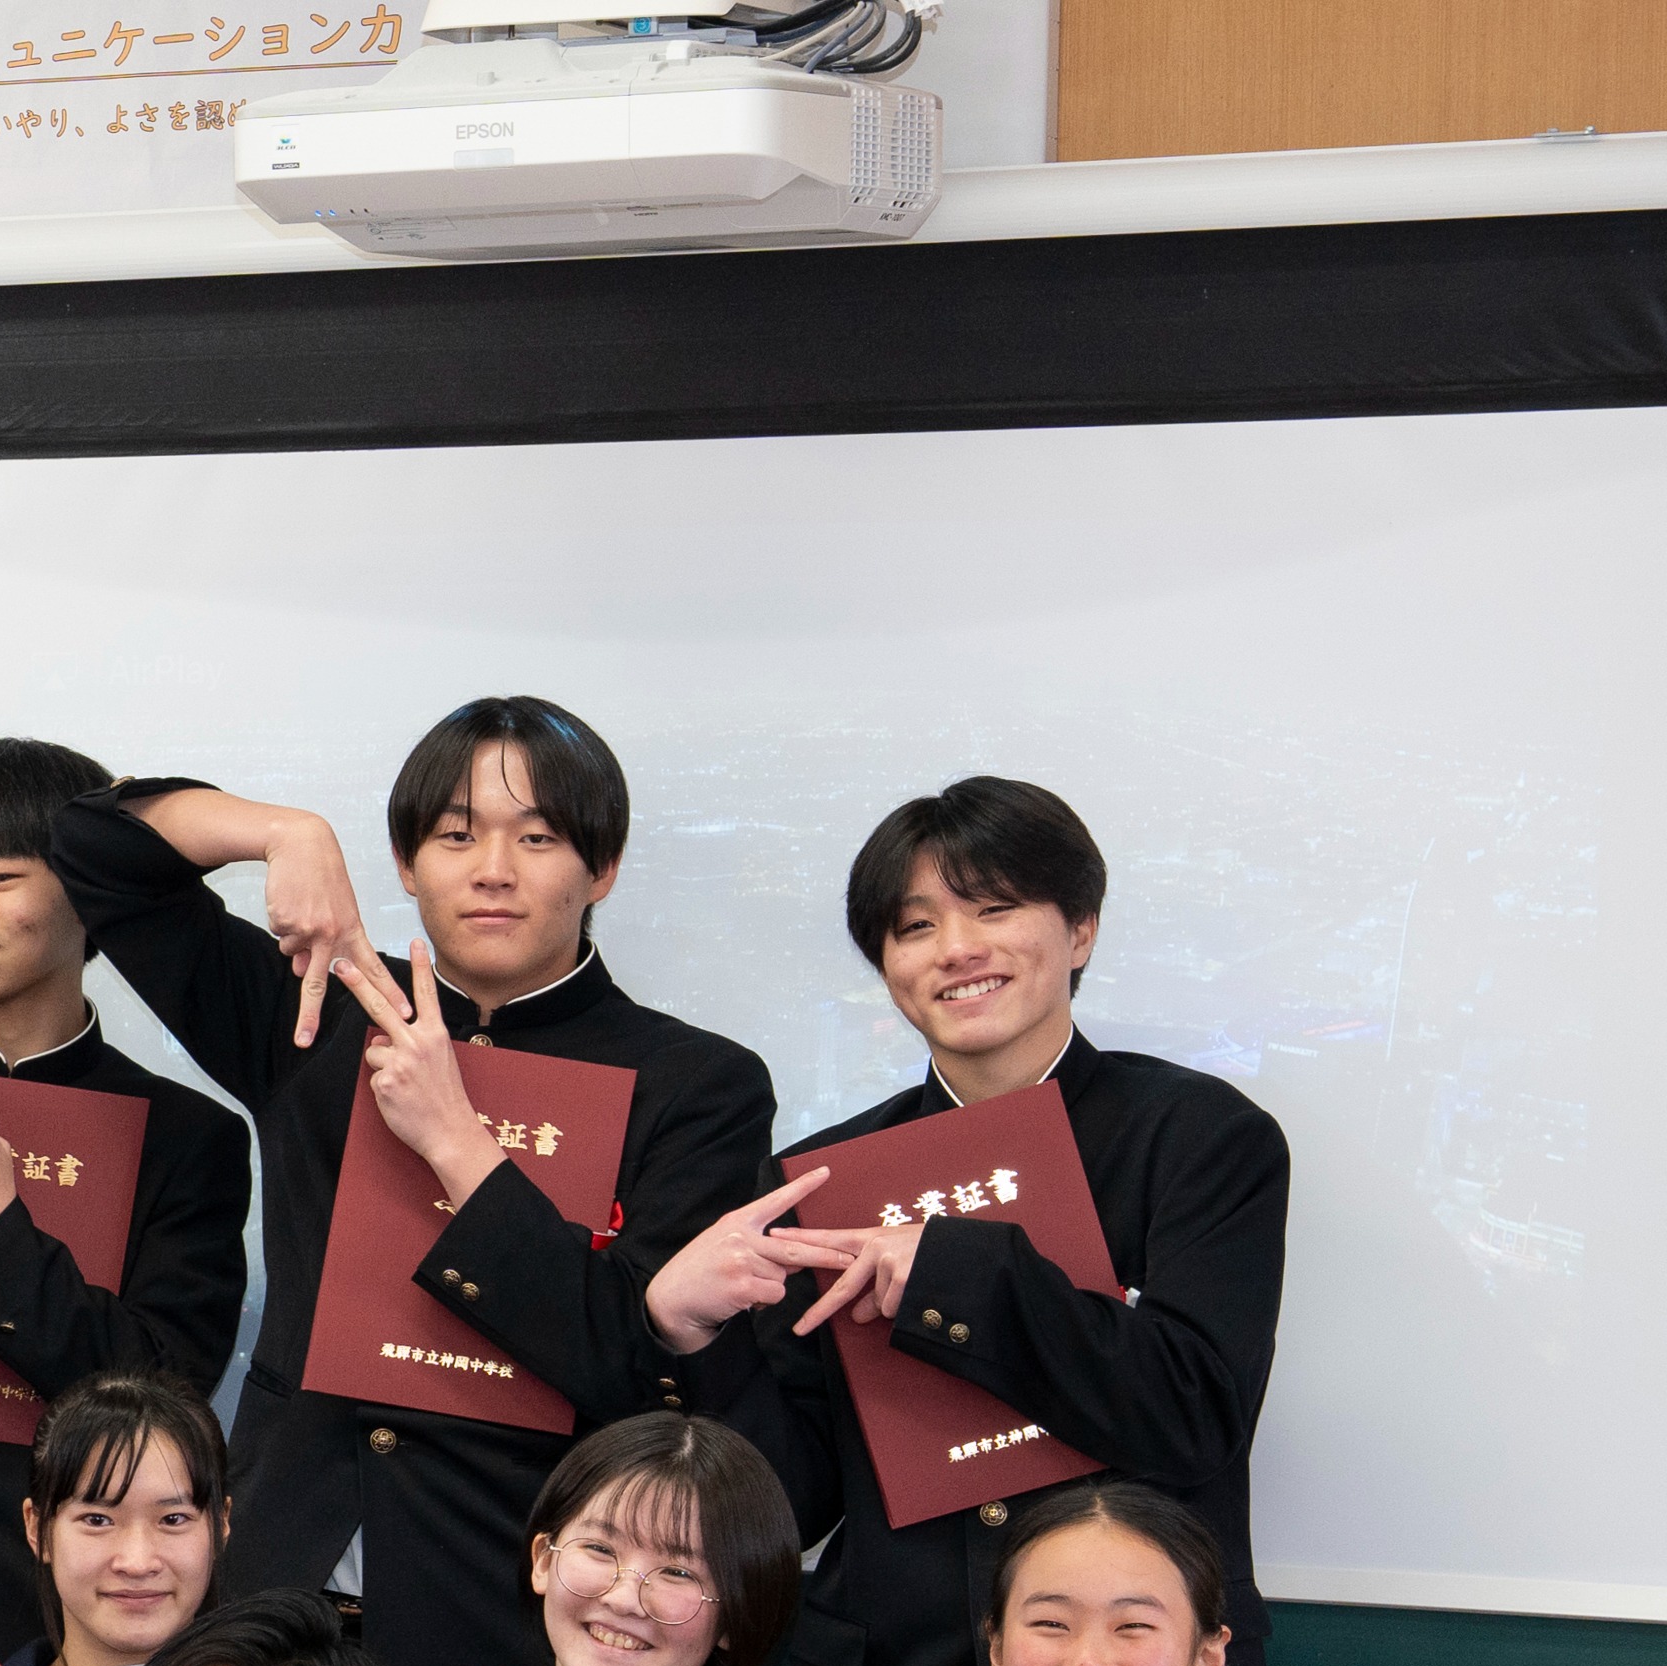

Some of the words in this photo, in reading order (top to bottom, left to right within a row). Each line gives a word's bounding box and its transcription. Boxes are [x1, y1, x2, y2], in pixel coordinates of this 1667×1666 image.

[455, 121, 515, 140] EPSON
[947, 1424, 1050, 1464] 飛騨市立神岡
